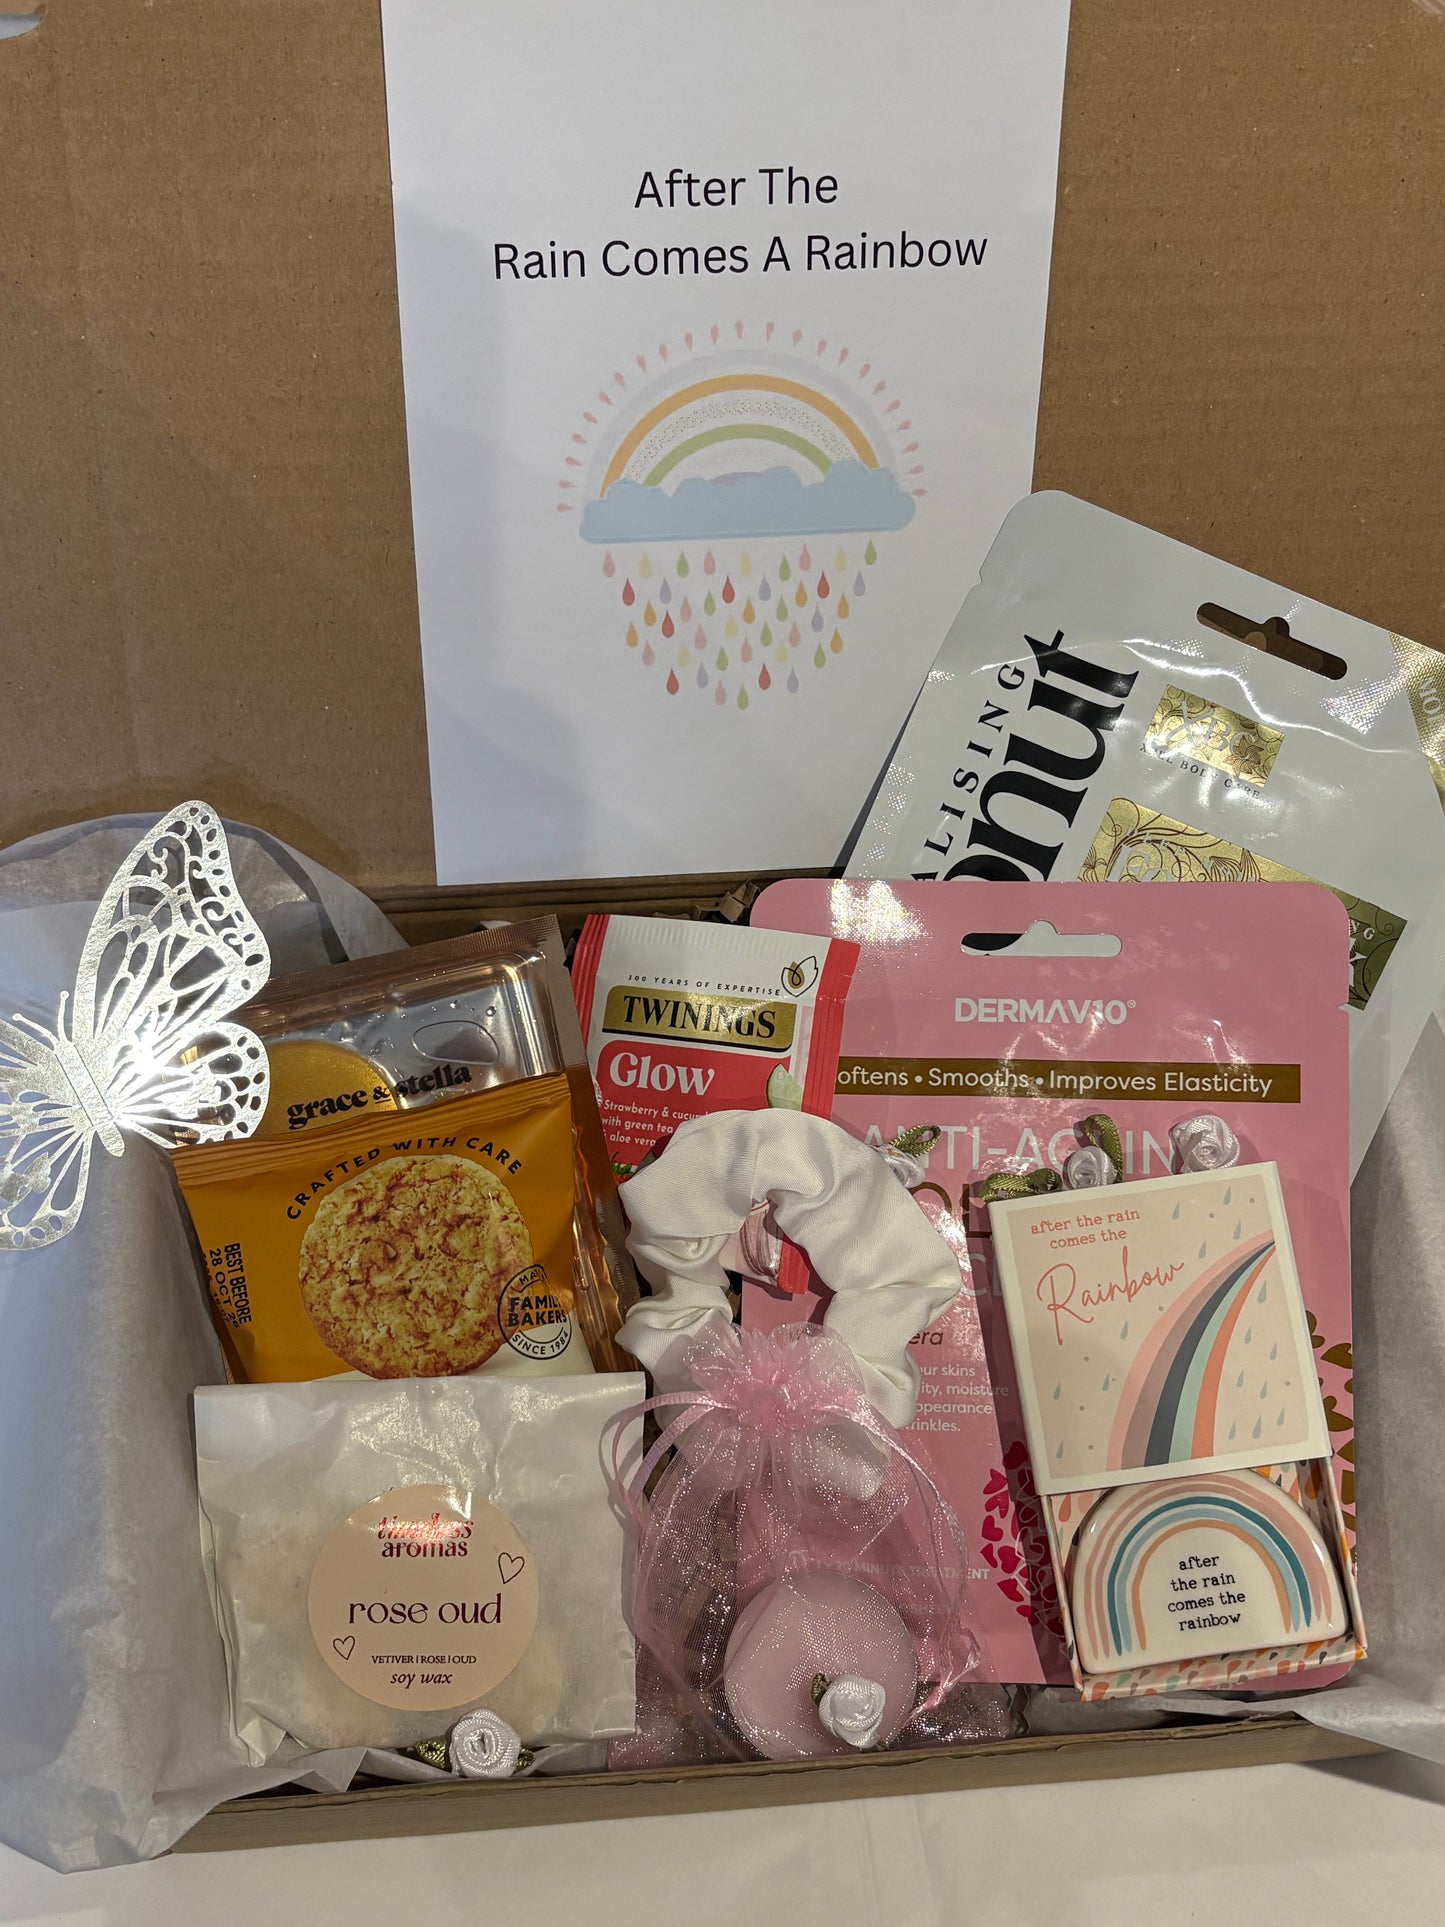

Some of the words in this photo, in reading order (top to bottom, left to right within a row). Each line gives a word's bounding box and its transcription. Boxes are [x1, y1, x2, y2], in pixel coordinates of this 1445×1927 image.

[634, 168, 746, 208] After
[759, 166, 839, 204] The
[494, 241, 586, 280] Rain
[602, 240, 749, 276] Comes
[762, 236, 791, 272] A
[806, 231, 988, 271] Rainbow
[654, 976, 689, 986] YEARS
[696, 981, 710, 989] OF
[718, 983, 781, 996] EXPERTISE
[624, 995, 776, 1039] TWININGS
[609, 1051, 715, 1096] Glow
[835, 1066, 909, 1086] oftens
[928, 1067, 1030, 1088] Smooths
[1050, 1070, 1157, 1095] Improves
[1164, 1072, 1273, 1098] Elasticity
[287, 1087, 369, 1130] grace
[372, 1085, 392, 1105] &
[395, 1064, 473, 1097] stella
[604, 1100, 659, 1118] Strawberry
[661, 1106, 669, 1118] &
[601, 1116, 621, 1126] with
[624, 1121, 653, 1131] green
[656, 1123, 674, 1134] tea
[610, 1131, 631, 1144] aloe
[634, 1137, 656, 1147] vera
[286, 1148, 381, 1220] CRAFTED
[393, 1137, 457, 1151] WITH
[466, 1137, 523, 1175] CARE
[1031, 1219, 1071, 1235] after
[1076, 1214, 1103, 1228] the
[1107, 1209, 1140, 1224] rain
[1050, 1234, 1096, 1249] comes
[1100, 1229, 1127, 1242] the
[209, 1248, 223, 1267] 28
[224, 1243, 244, 1274] BEST
[215, 1271, 233, 1306] OCT
[1037, 1245, 1185, 1345] Rainbow
[229, 1276, 253, 1325] BEFORE
[508, 1309, 568, 1327] BAKERS
[512, 1334, 546, 1355] SINCE
[908, 1331, 944, 1345] era
[941, 1364, 976, 1377] skins
[946, 1382, 1009, 1396] moisture
[902, 1418, 961, 1432] rinkles.
[381, 1541, 468, 1558] aromas
[1179, 1555, 1219, 1570] after
[1170, 1578, 1197, 1592] the
[1202, 1572, 1235, 1588] rain
[349, 1602, 428, 1624] rose
[438, 1593, 502, 1624] oud
[1168, 1596, 1214, 1612] comes
[1219, 1591, 1246, 1605] the
[1178, 1613, 1241, 1631] rainbow
[371, 1655, 414, 1664] VETIVER
[420, 1655, 446, 1664] ROSE
[452, 1655, 476, 1664] OUD
[390, 1673, 415, 1689] soy
[420, 1673, 453, 1684] wax
